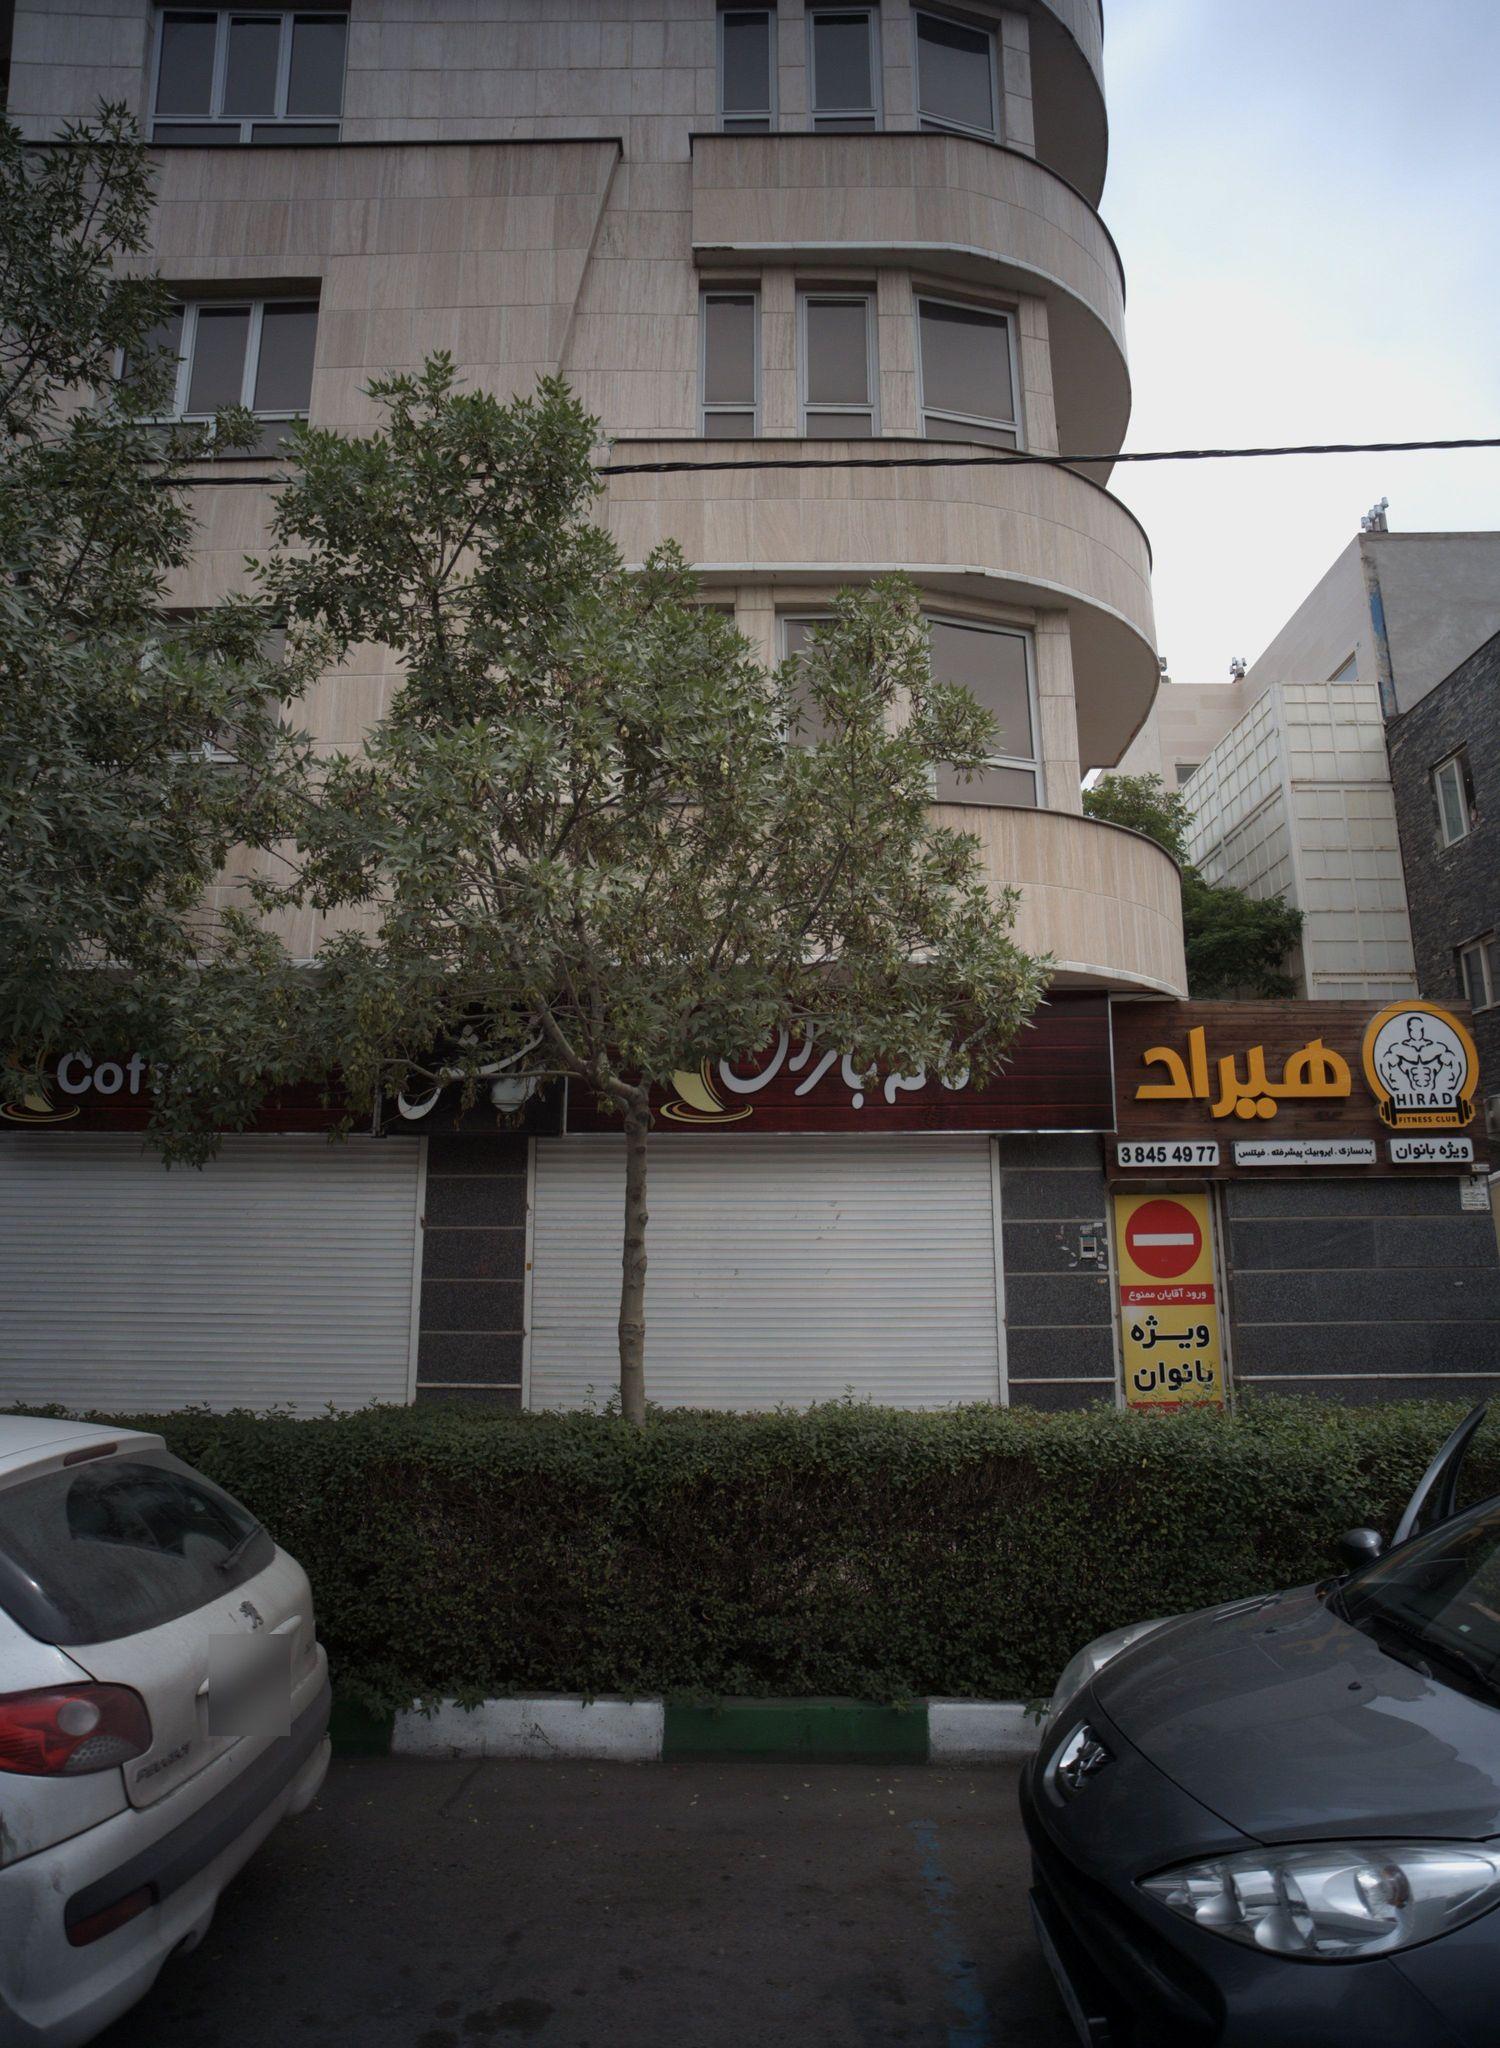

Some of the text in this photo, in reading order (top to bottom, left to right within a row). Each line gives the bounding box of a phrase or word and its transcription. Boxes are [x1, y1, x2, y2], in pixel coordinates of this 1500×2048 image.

[1135, 1025, 1351, 1120] هیراد
[1396, 1092, 1453, 1106] HIRAD
[1398, 1115, 1457, 1124] FITNESS CLUB
[1395, 1141, 1469, 1159] ویژه بانوان
[1128, 1287, 1207, 1302] ورود آقایان ممنوع
[1130, 1314, 1210, 1349] ویژه
[1133, 1359, 1214, 1392] بانوان
